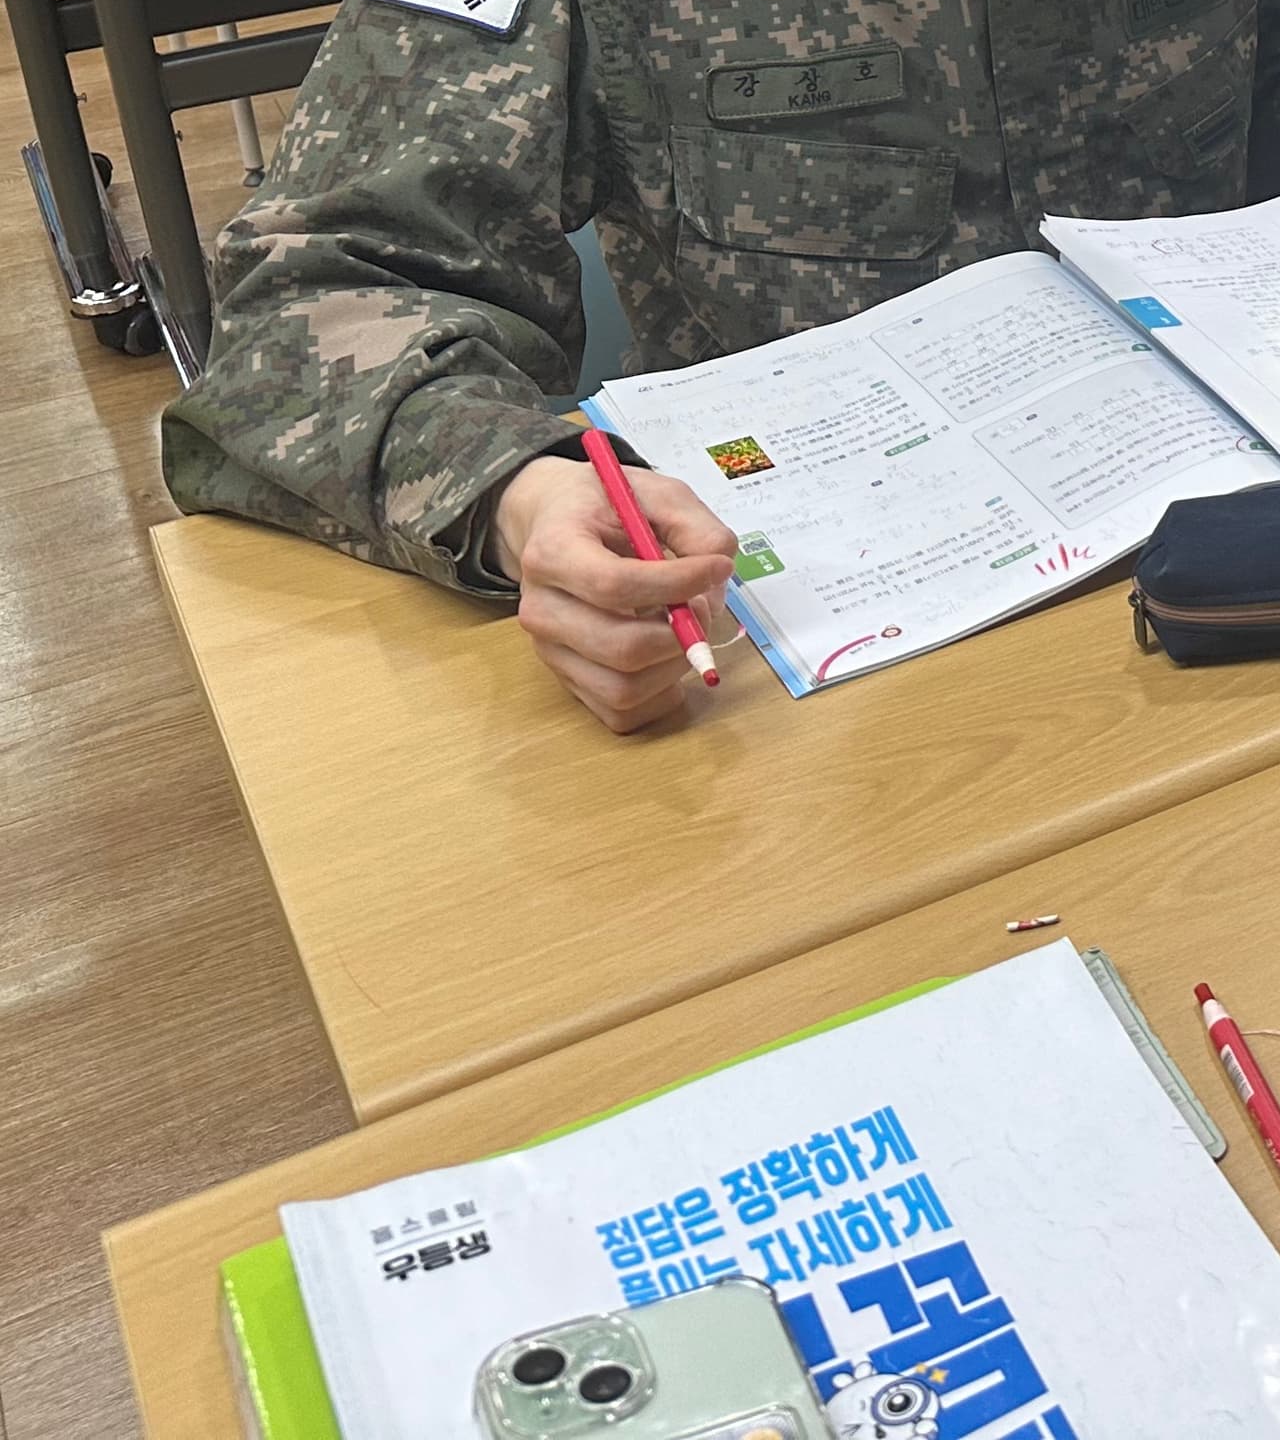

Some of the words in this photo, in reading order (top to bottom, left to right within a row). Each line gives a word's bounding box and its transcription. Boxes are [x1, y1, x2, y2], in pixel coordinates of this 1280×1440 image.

[788, 90, 832, 108] KANG
[596, 1187, 727, 1270] 정답은
[719, 1105, 919, 1225] 정확하게
[383, 1230, 491, 1281] 우등생
[748, 1172, 953, 1286] 자세하게
